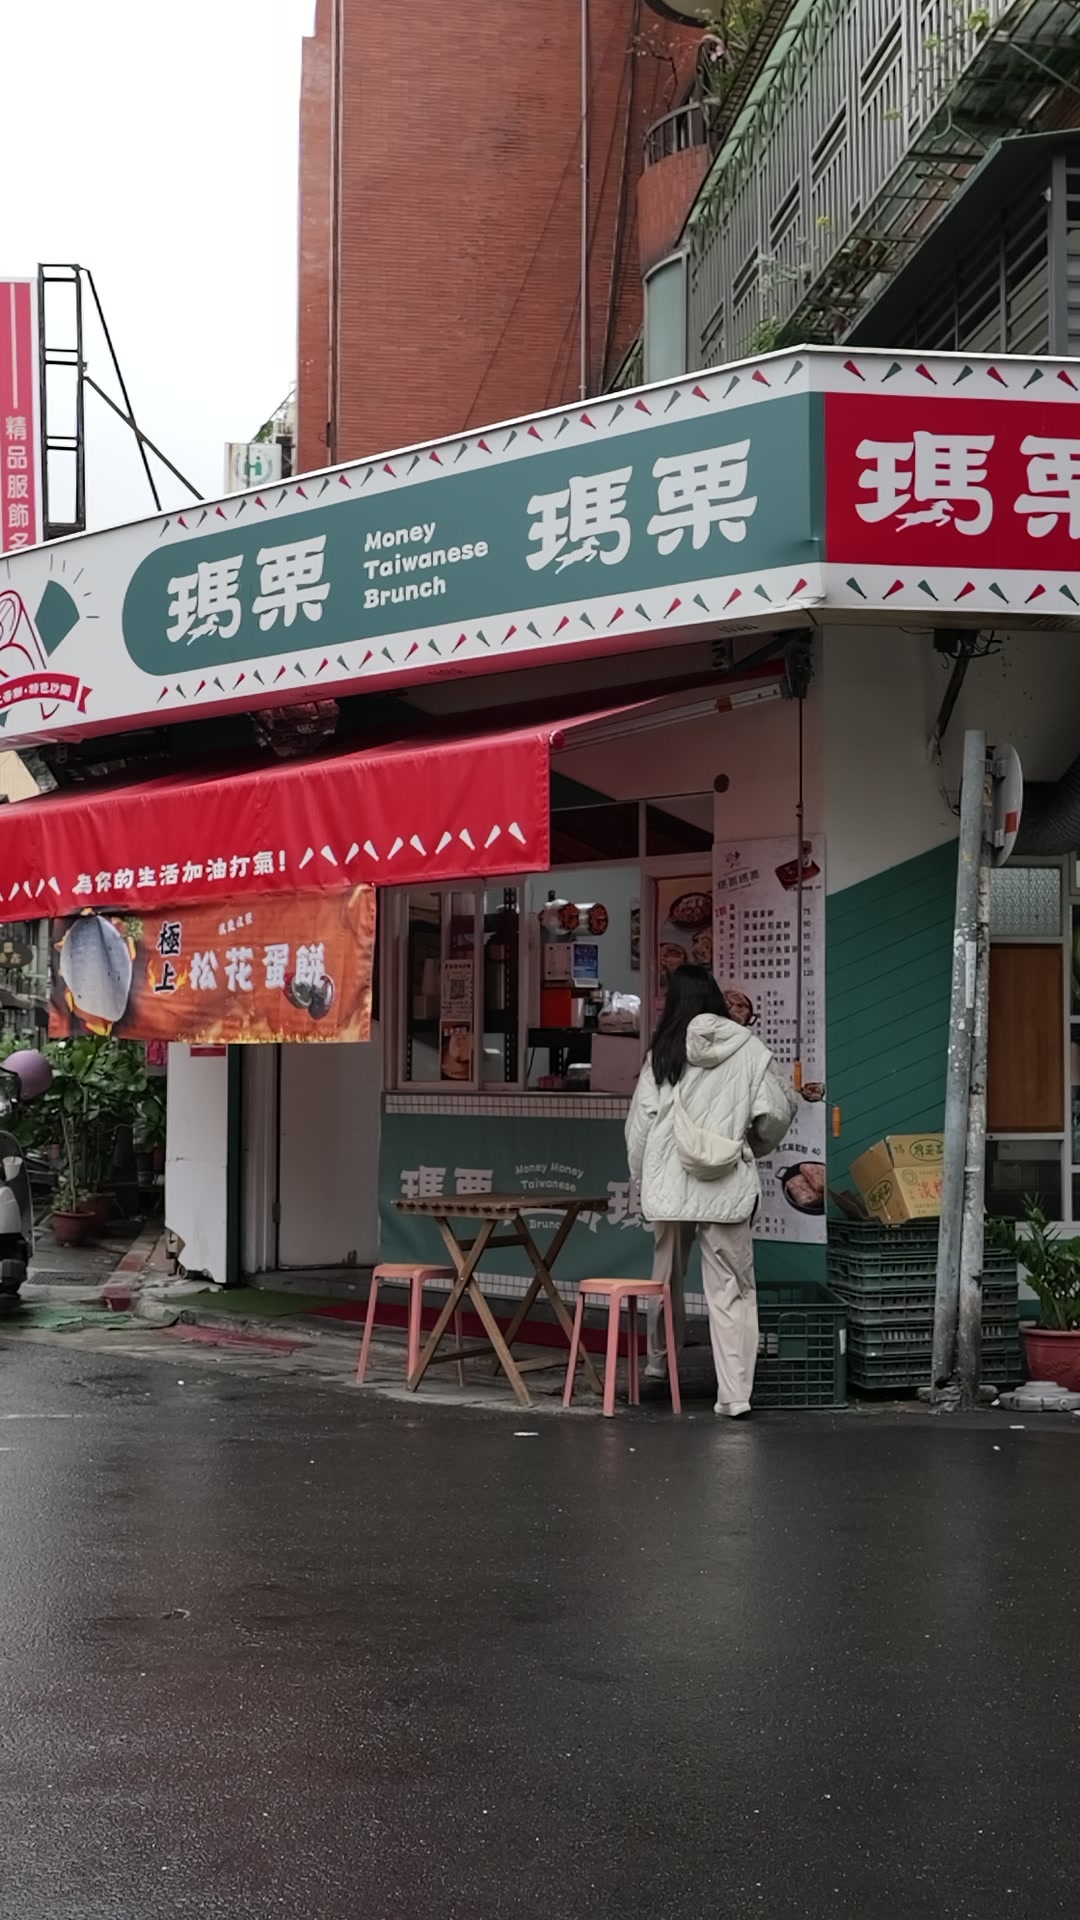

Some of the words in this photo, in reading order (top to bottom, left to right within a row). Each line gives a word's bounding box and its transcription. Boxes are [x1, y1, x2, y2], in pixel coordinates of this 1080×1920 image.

[526, 439, 757, 575] 瑪栗
[364, 521, 437, 552] Money
[363, 540, 489, 580] Taiwanese
[166, 534, 331, 645] 瑪栗
[363, 575, 446, 609] Brunch
[153, 921, 182, 994] 極上
[189, 941, 326, 992] 松花蛋餅
[515, 1162, 549, 1176] Money
[550, 1162, 584, 1180] Money
[520, 1179, 577, 1193] Taiwanese
[529, 1219, 562, 1230] Brunc
